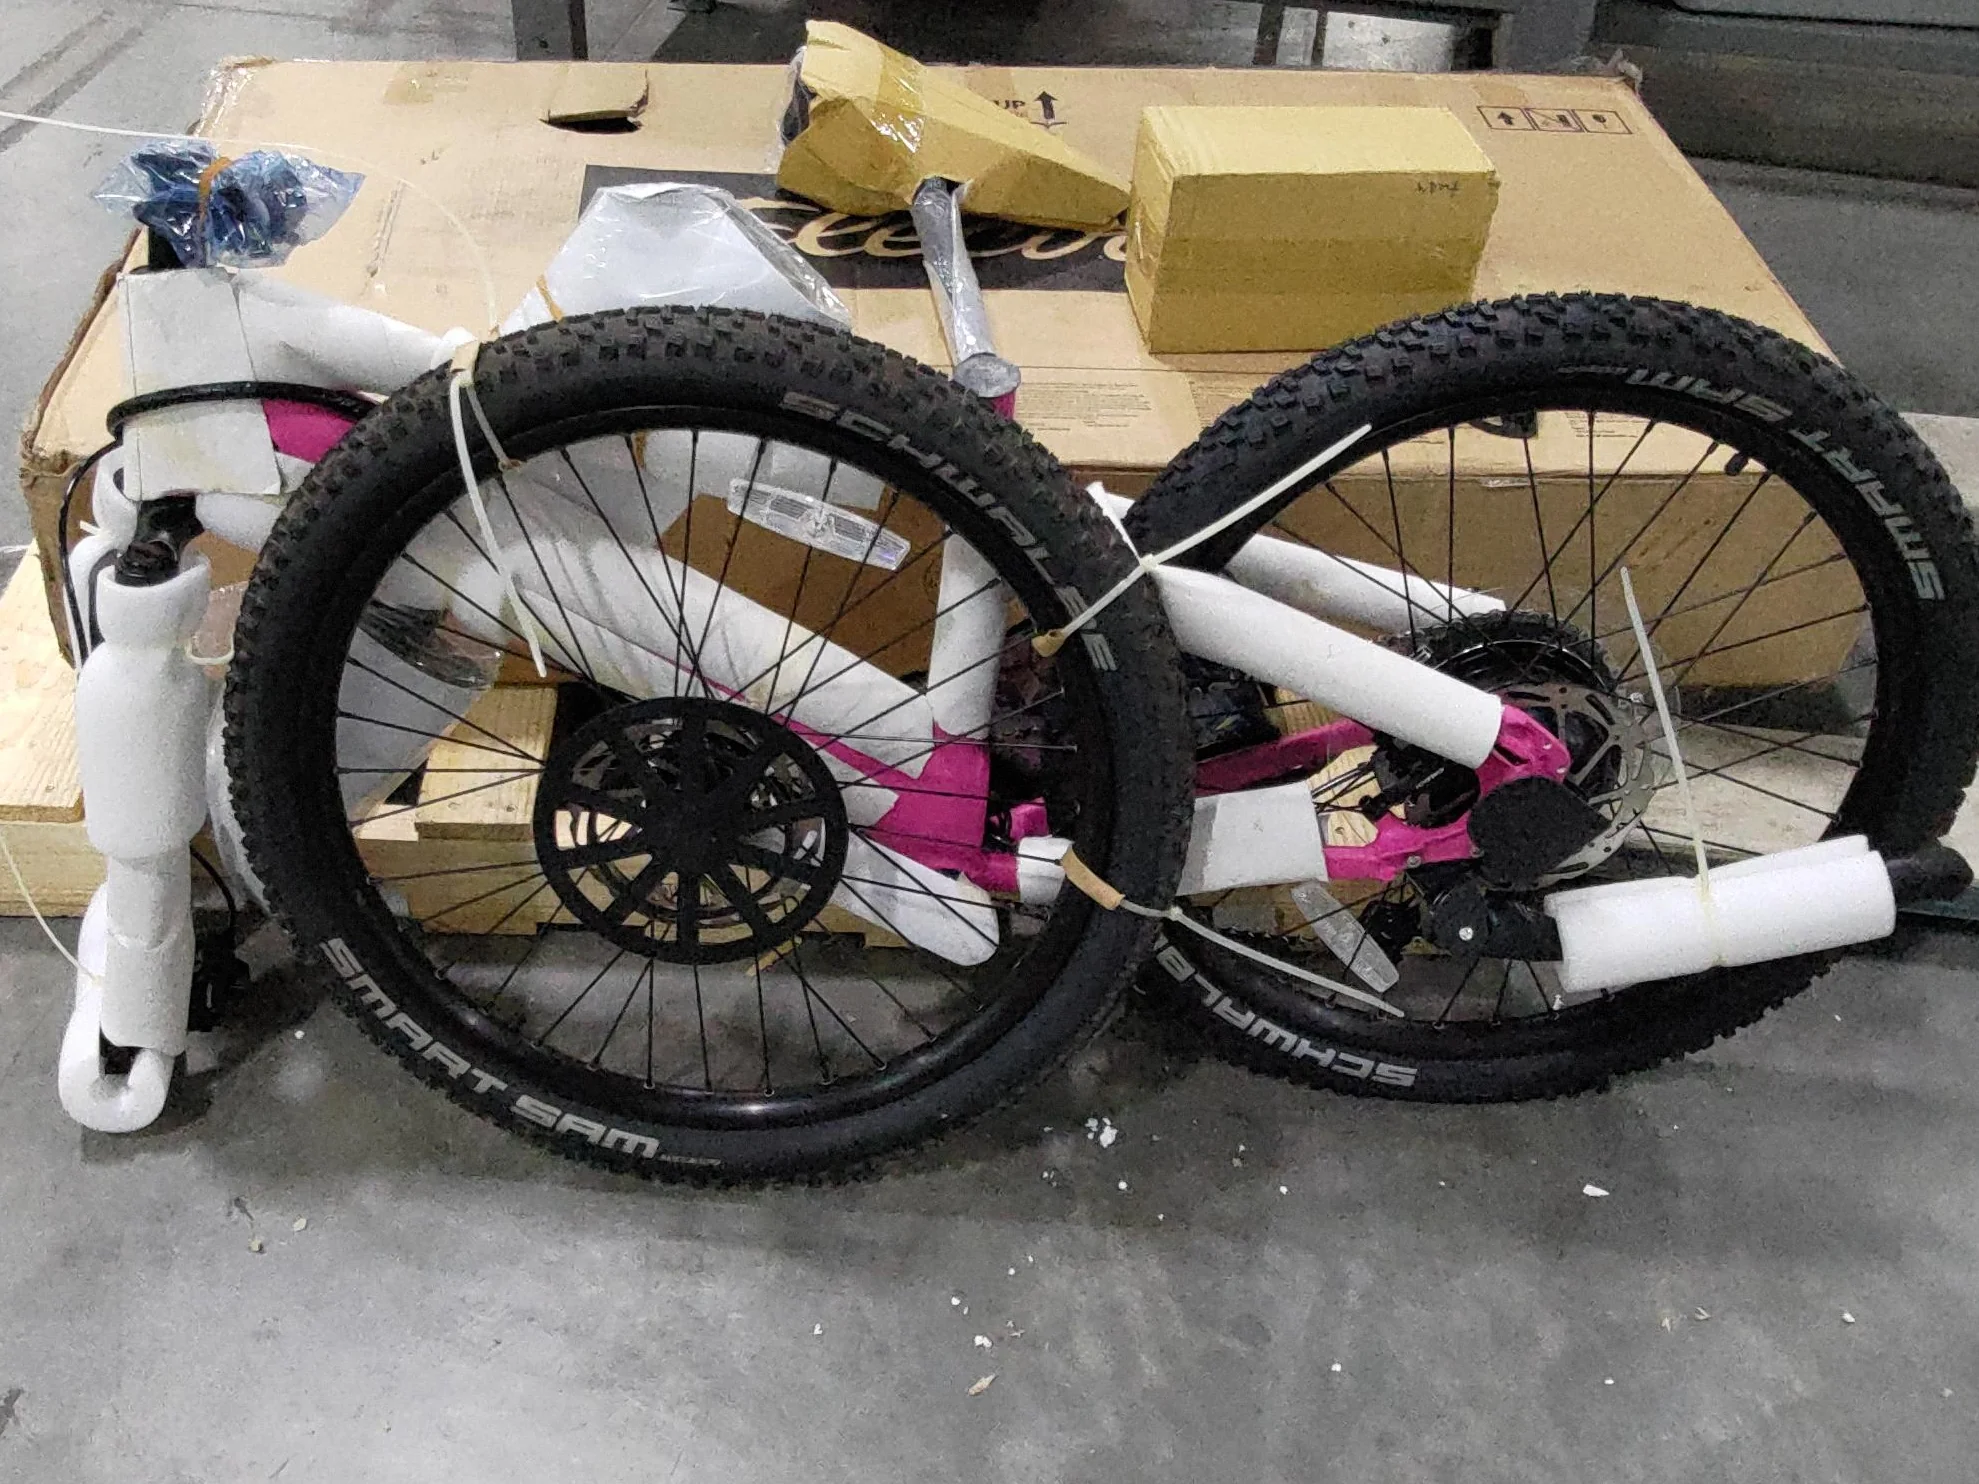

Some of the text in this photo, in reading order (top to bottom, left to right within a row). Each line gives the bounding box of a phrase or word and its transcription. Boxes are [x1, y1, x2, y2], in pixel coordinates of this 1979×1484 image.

[778, 391, 1118, 671] SCHWALBE
[1625, 368, 1946, 601] SMART SAM
[319, 937, 661, 1159] SMART SAM
[1153, 932, 1418, 1087] SCHWALB
